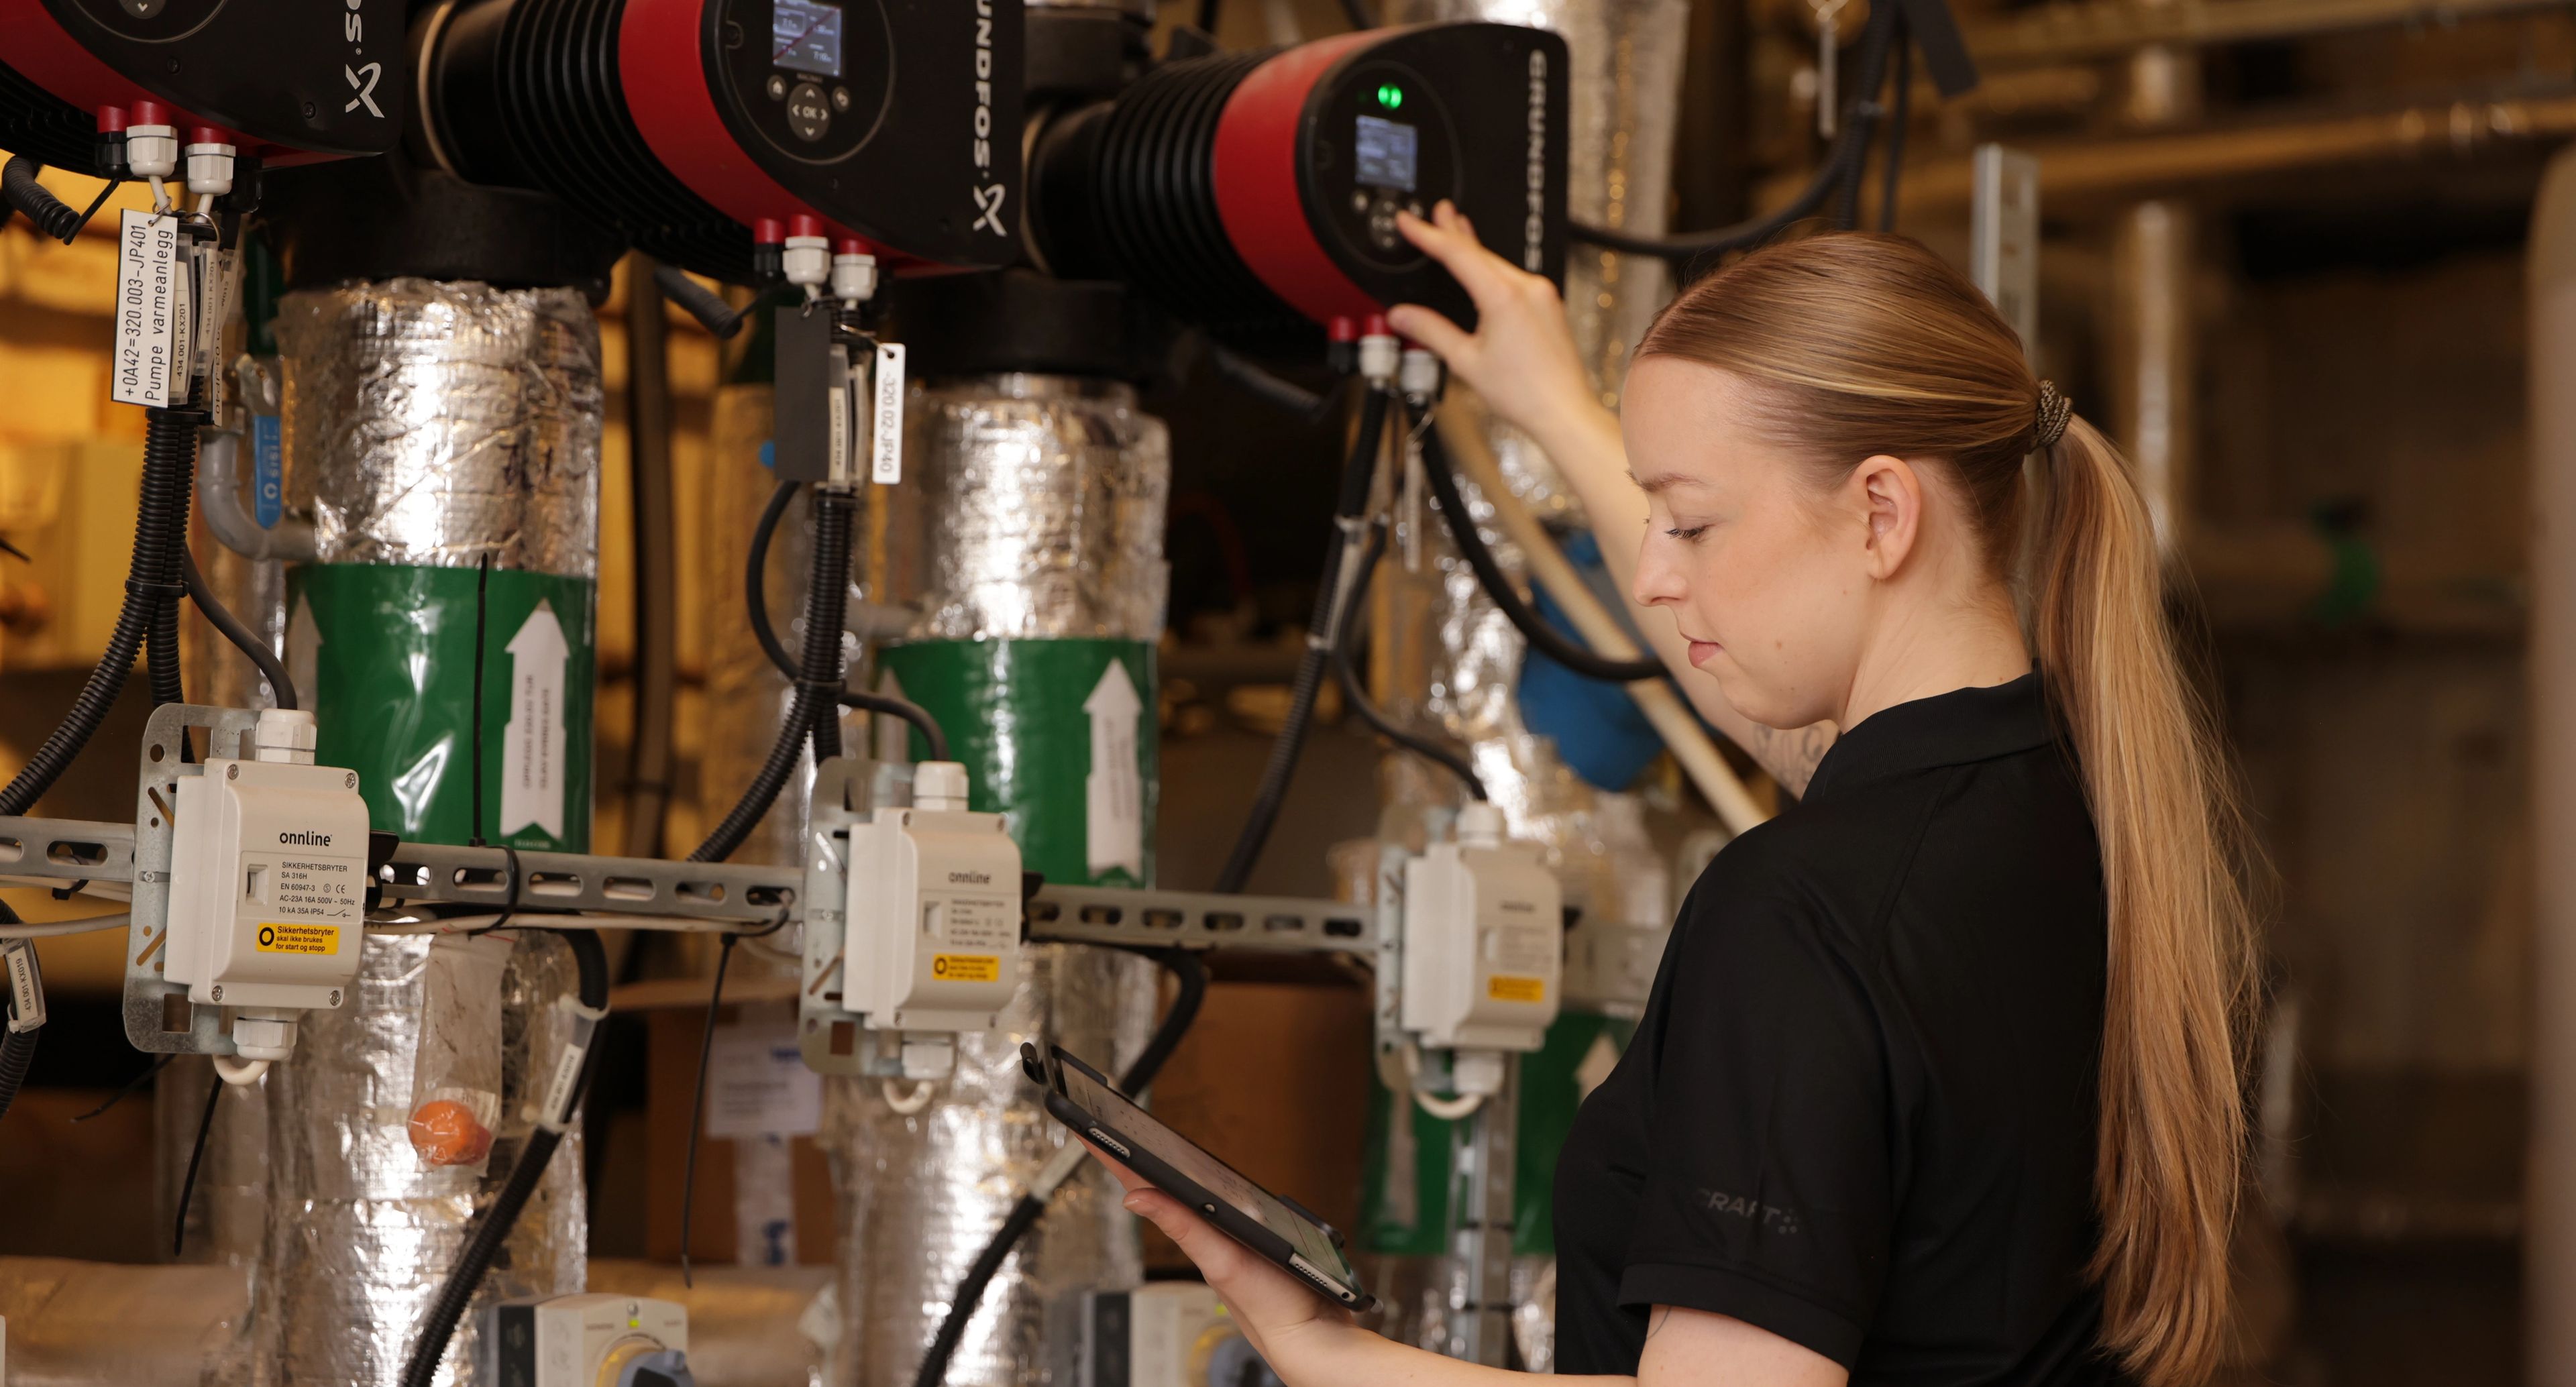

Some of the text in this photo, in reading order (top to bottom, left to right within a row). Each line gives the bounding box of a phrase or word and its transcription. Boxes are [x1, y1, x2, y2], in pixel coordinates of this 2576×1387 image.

[803, 106, 817, 119] OK
[145, 230, 173, 400] Pumpe varmeanlegg
[176, 303, 186, 380] -434.001-KX201
[279, 831, 331, 846] onnline
[282, 862, 347, 872] SIKKERHETSBRYTER
[280, 895, 303, 903] AC-23A
[277, 926, 334, 937] Sikkerhetsbryter
